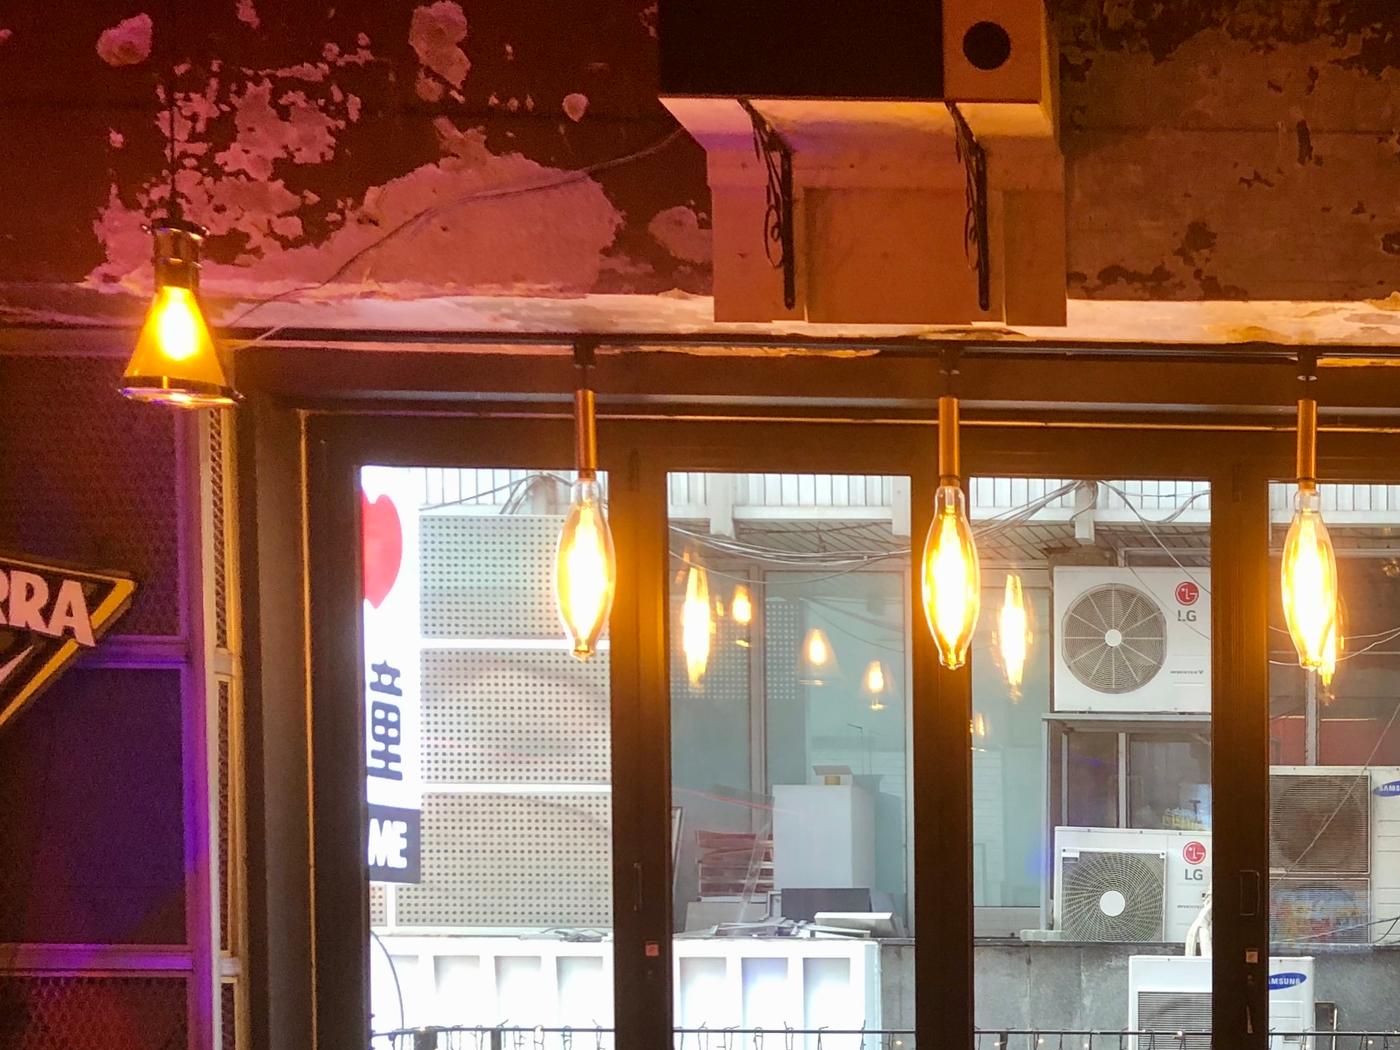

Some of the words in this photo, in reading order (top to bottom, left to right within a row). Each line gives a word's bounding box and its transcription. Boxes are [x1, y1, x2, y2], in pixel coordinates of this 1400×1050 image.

[0, 568, 96, 647] RA
[1177, 609, 1197, 622] LG
[1184, 868, 1204, 881] LG
